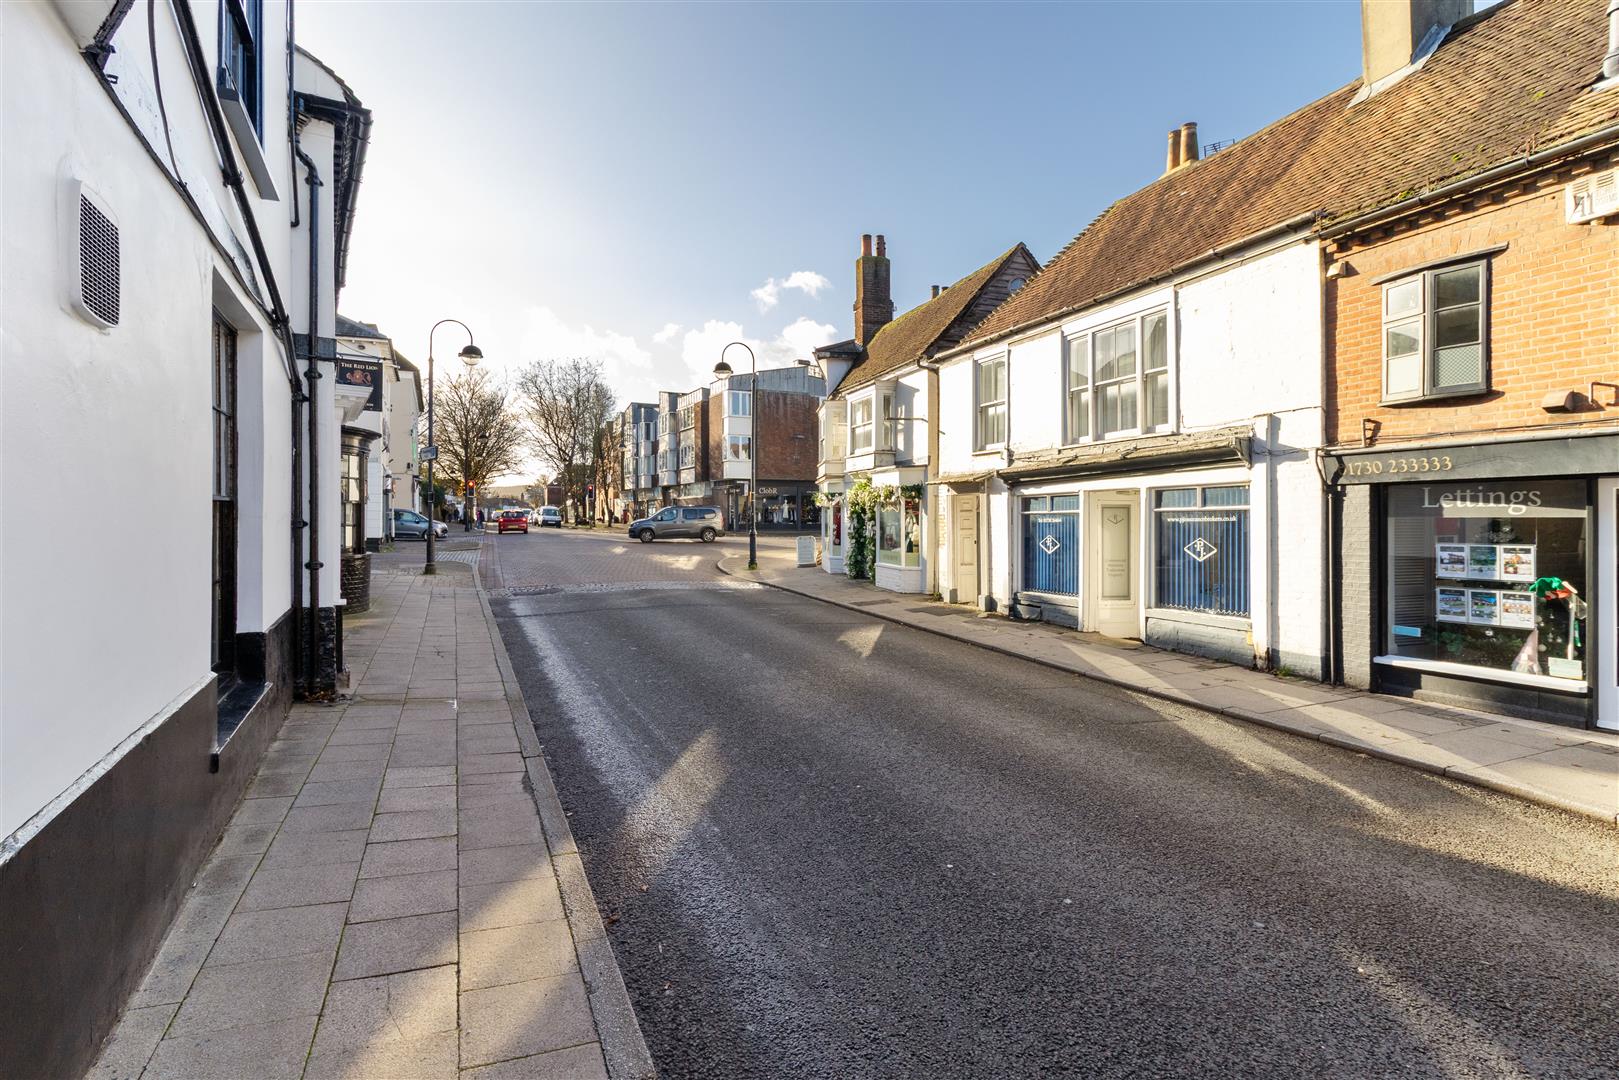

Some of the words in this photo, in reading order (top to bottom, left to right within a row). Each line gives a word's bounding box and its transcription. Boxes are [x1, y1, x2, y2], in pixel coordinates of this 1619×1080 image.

[1343, 461, 1383, 475] 1730
[1388, 456, 1452, 473] 233333
[1422, 486, 1542, 515] Lettings
